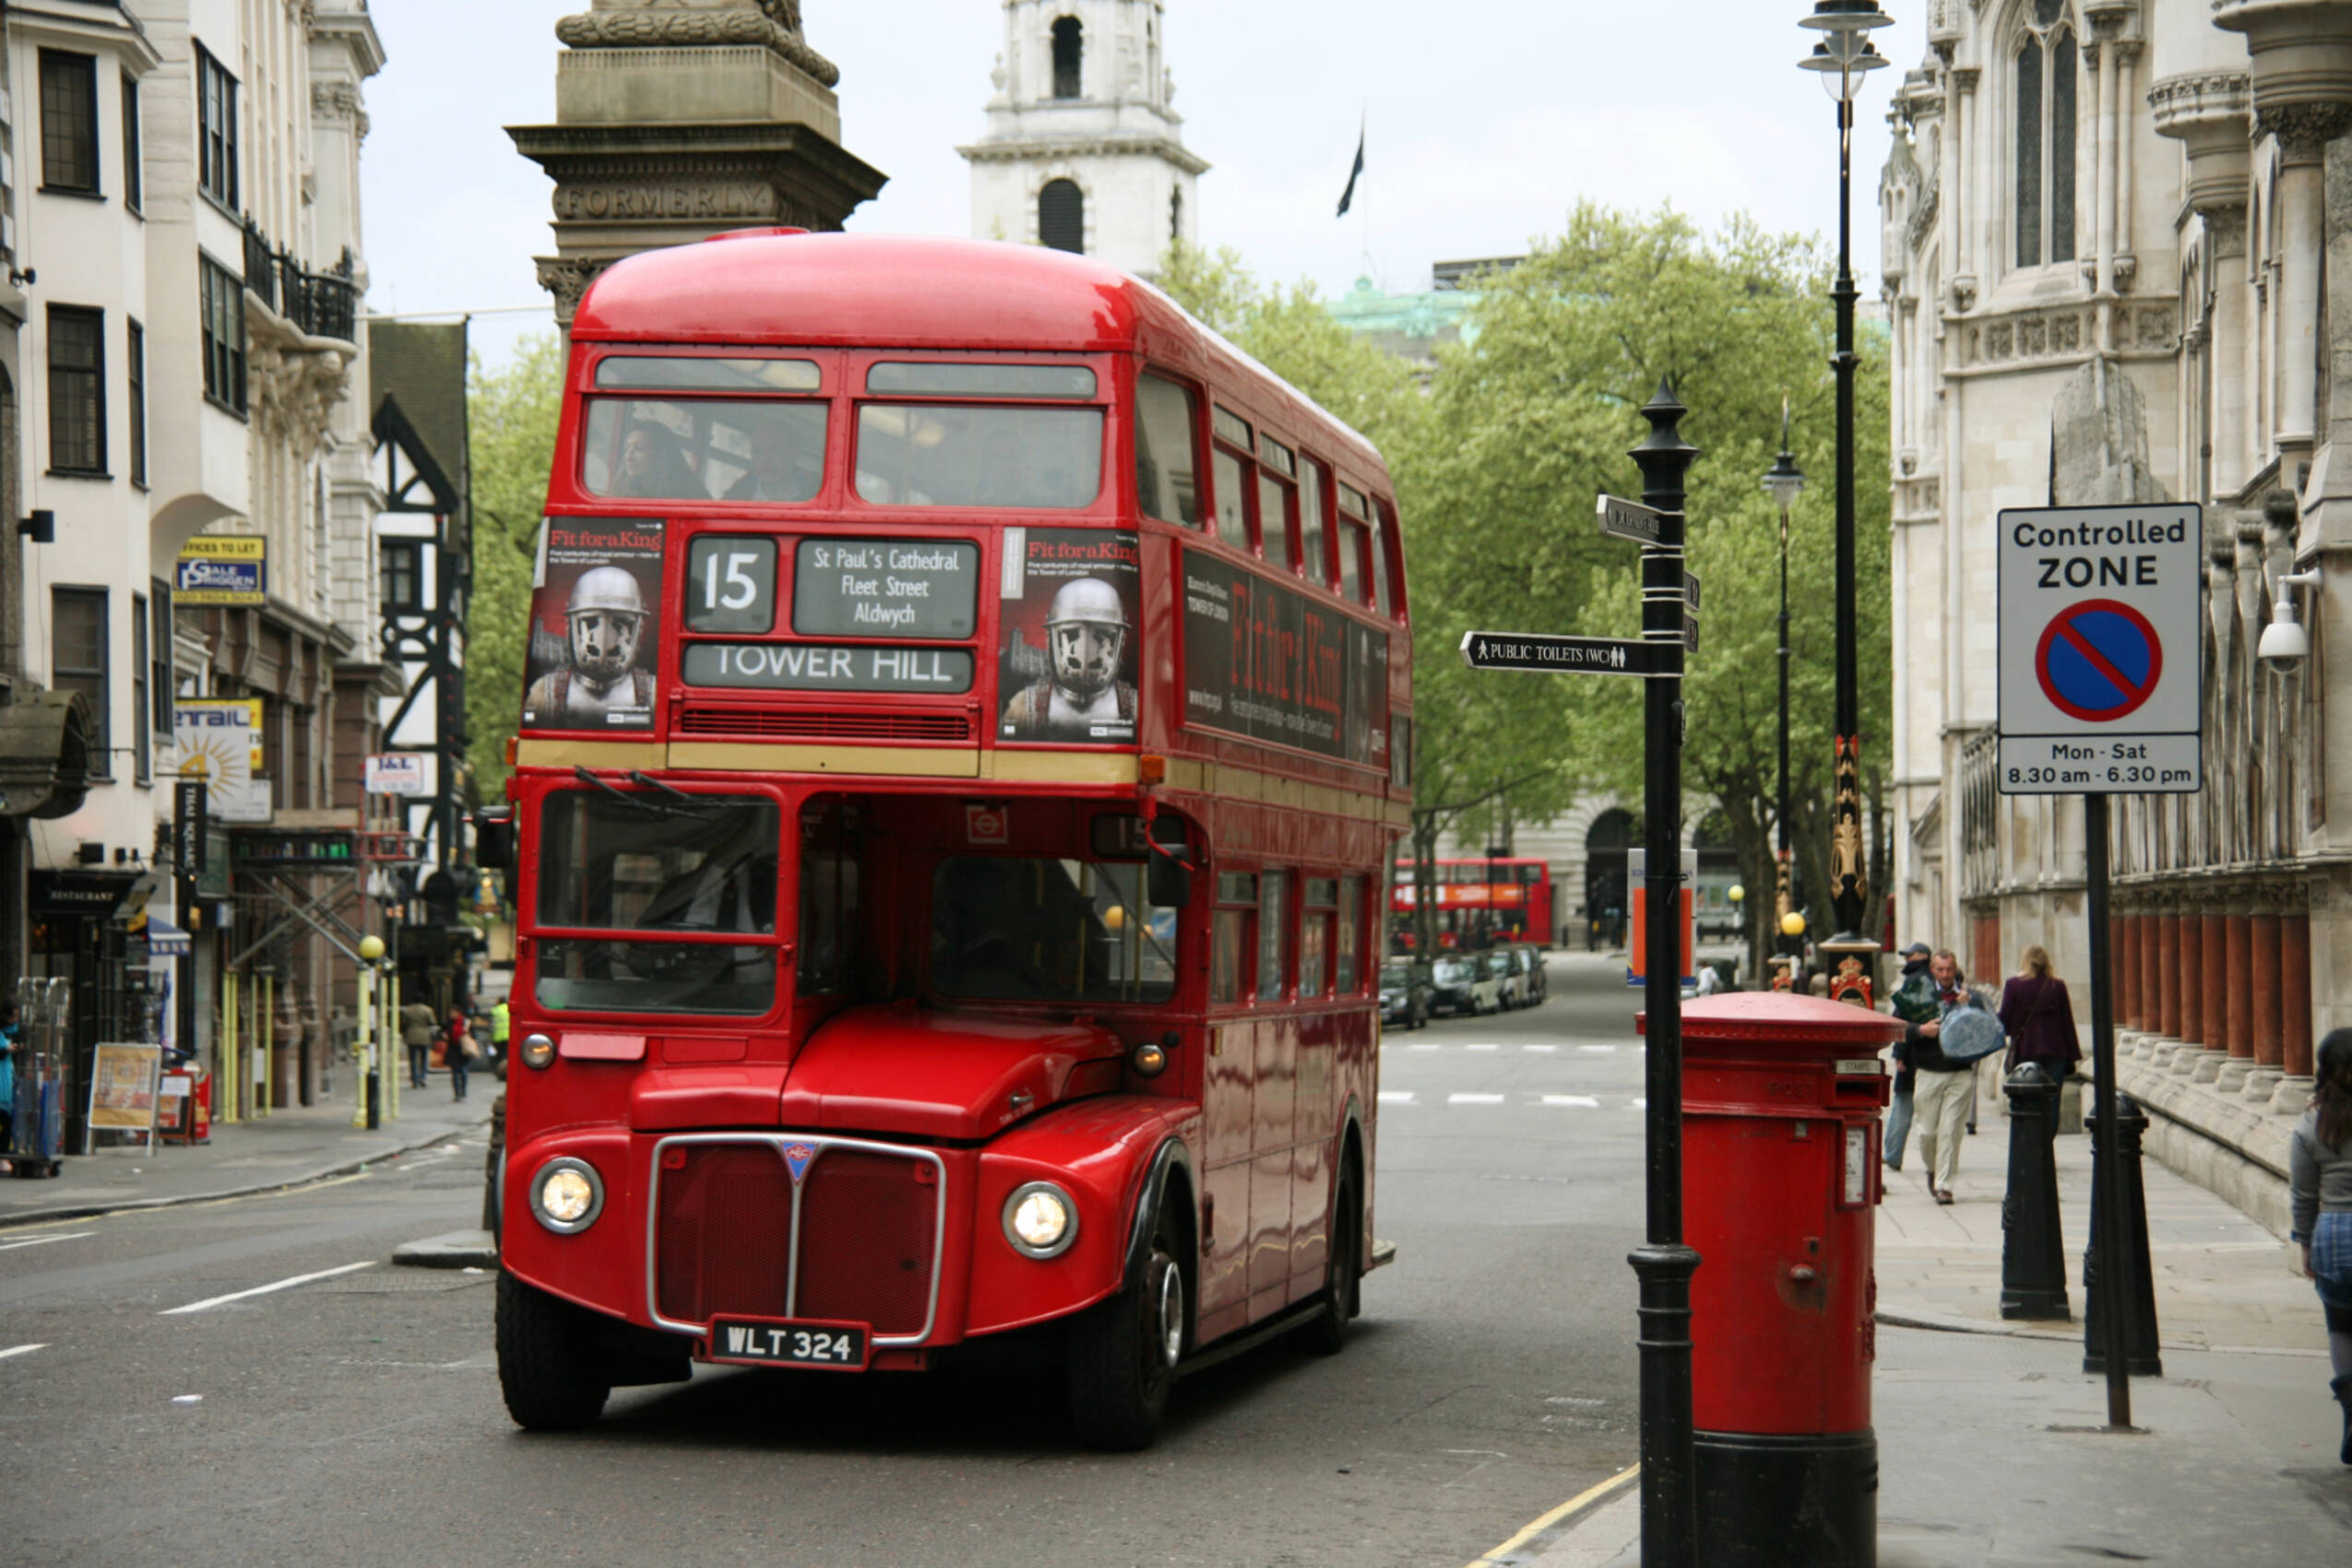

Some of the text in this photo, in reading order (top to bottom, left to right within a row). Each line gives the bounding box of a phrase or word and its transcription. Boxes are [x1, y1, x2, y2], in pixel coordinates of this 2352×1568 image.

[564, 184, 764, 219] FORMERLY
[550, 529, 663, 552] Fit for a King
[2013, 517, 2186, 548] Controlled
[221, 542, 234, 552] TO
[237, 543, 255, 553] LET
[814, 547, 960, 571] St Paul's Cathedral
[1028, 540, 1138, 565] Fit for a King
[705, 552, 759, 611] 15
[2037, 555, 2158, 588] ZONE
[841, 575, 930, 598] Fleet Street
[854, 602, 916, 628] Aldwych
[714, 646, 953, 682] TOWER HILL
[1491, 644, 1610, 664] PUBLIC TOILETS (WC)
[2051, 743, 2094, 760] Mon
[2111, 742, 2147, 760] Sat
[2008, 767, 2056, 783] 8.30
[2061, 769, 2090, 783] am
[2107, 766, 2156, 782] 6.30
[2161, 767, 2192, 785] pm
[52, 891, 115, 901] RESTAURANT
[728, 1325, 851, 1360] WLT 324
